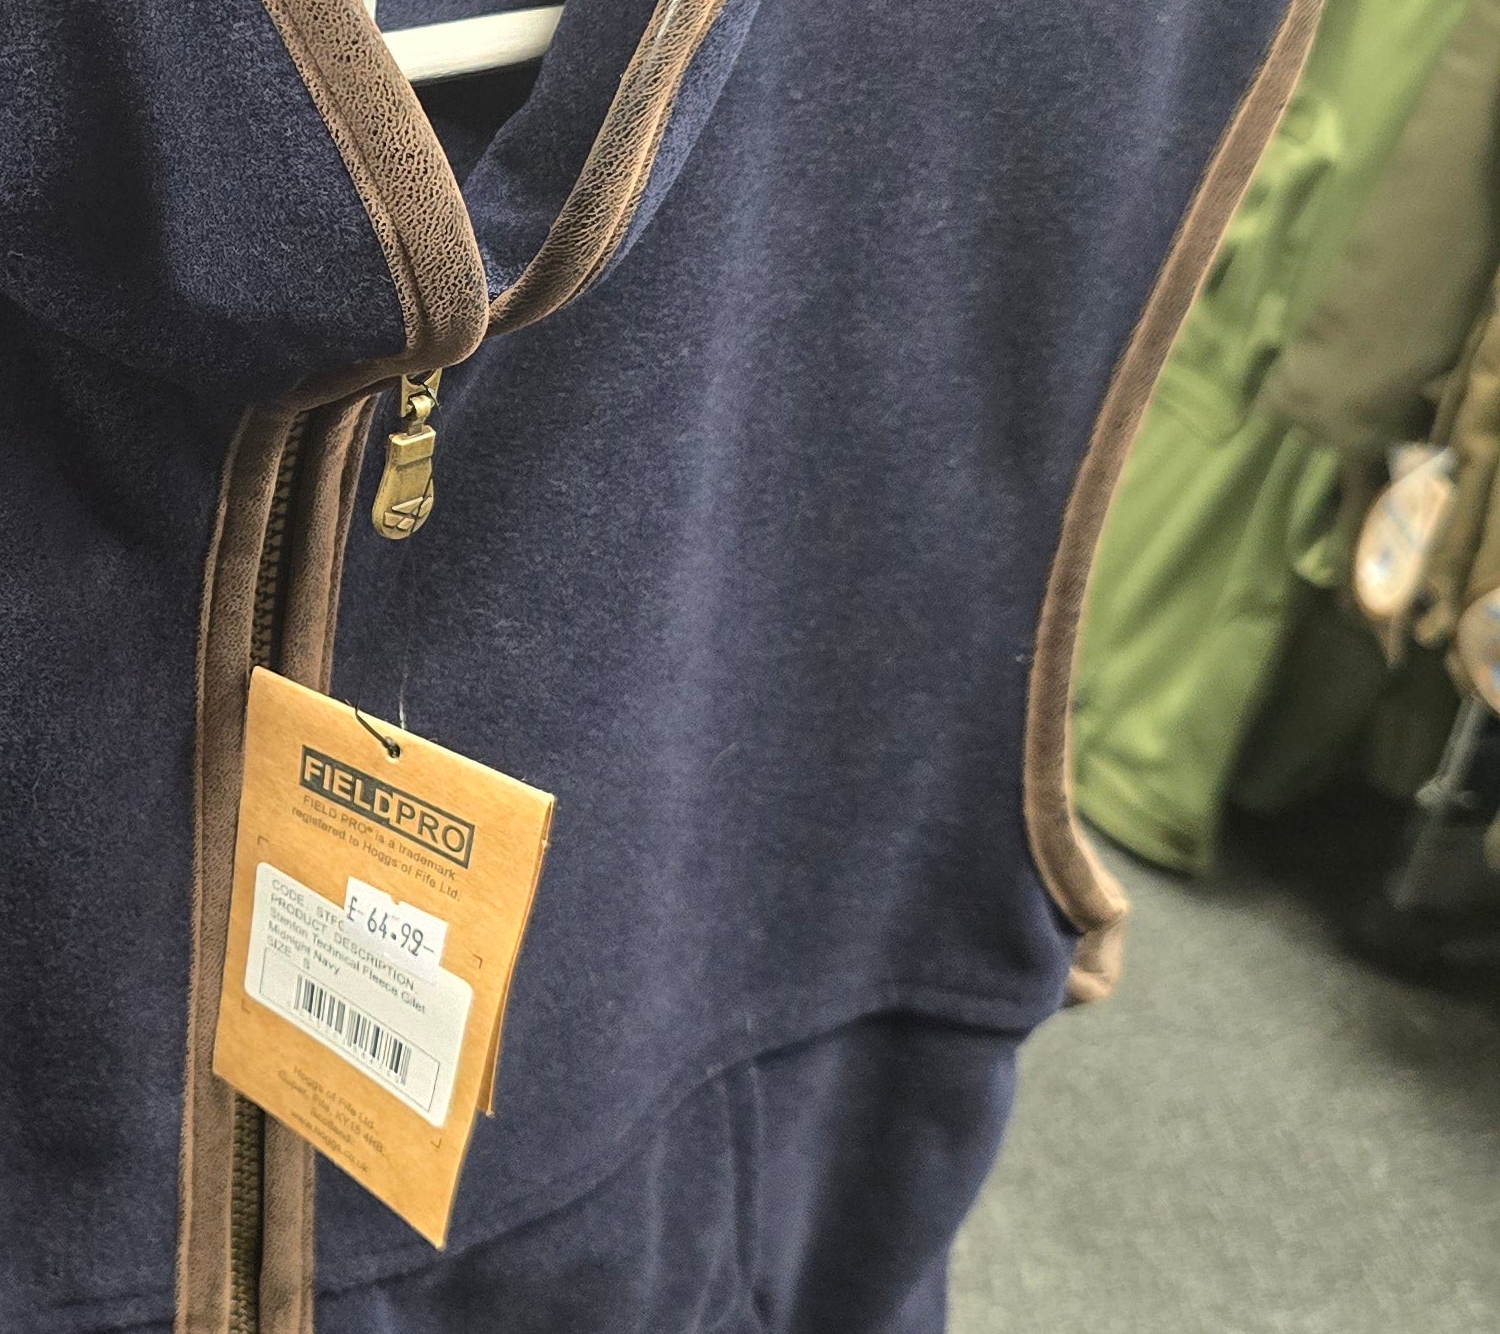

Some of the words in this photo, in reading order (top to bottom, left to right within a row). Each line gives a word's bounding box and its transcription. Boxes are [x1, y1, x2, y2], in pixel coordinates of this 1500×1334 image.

[292, 806, 346, 840] registered
[349, 834, 360, 847] to
[363, 841, 398, 869] Hoggs
[401, 862, 413, 876] of
[415, 869, 436, 889] Fife
[303, 794, 338, 819] FIELD
[375, 832, 385, 844] is
[399, 842, 456, 881] trademark
[270, 893, 328, 935] PRODUCT
[312, 930, 360, 972] Technical
[362, 966, 398, 997] Fleece
[401, 991, 426, 1015] Gilet
[313, 948, 340, 976] Navy
